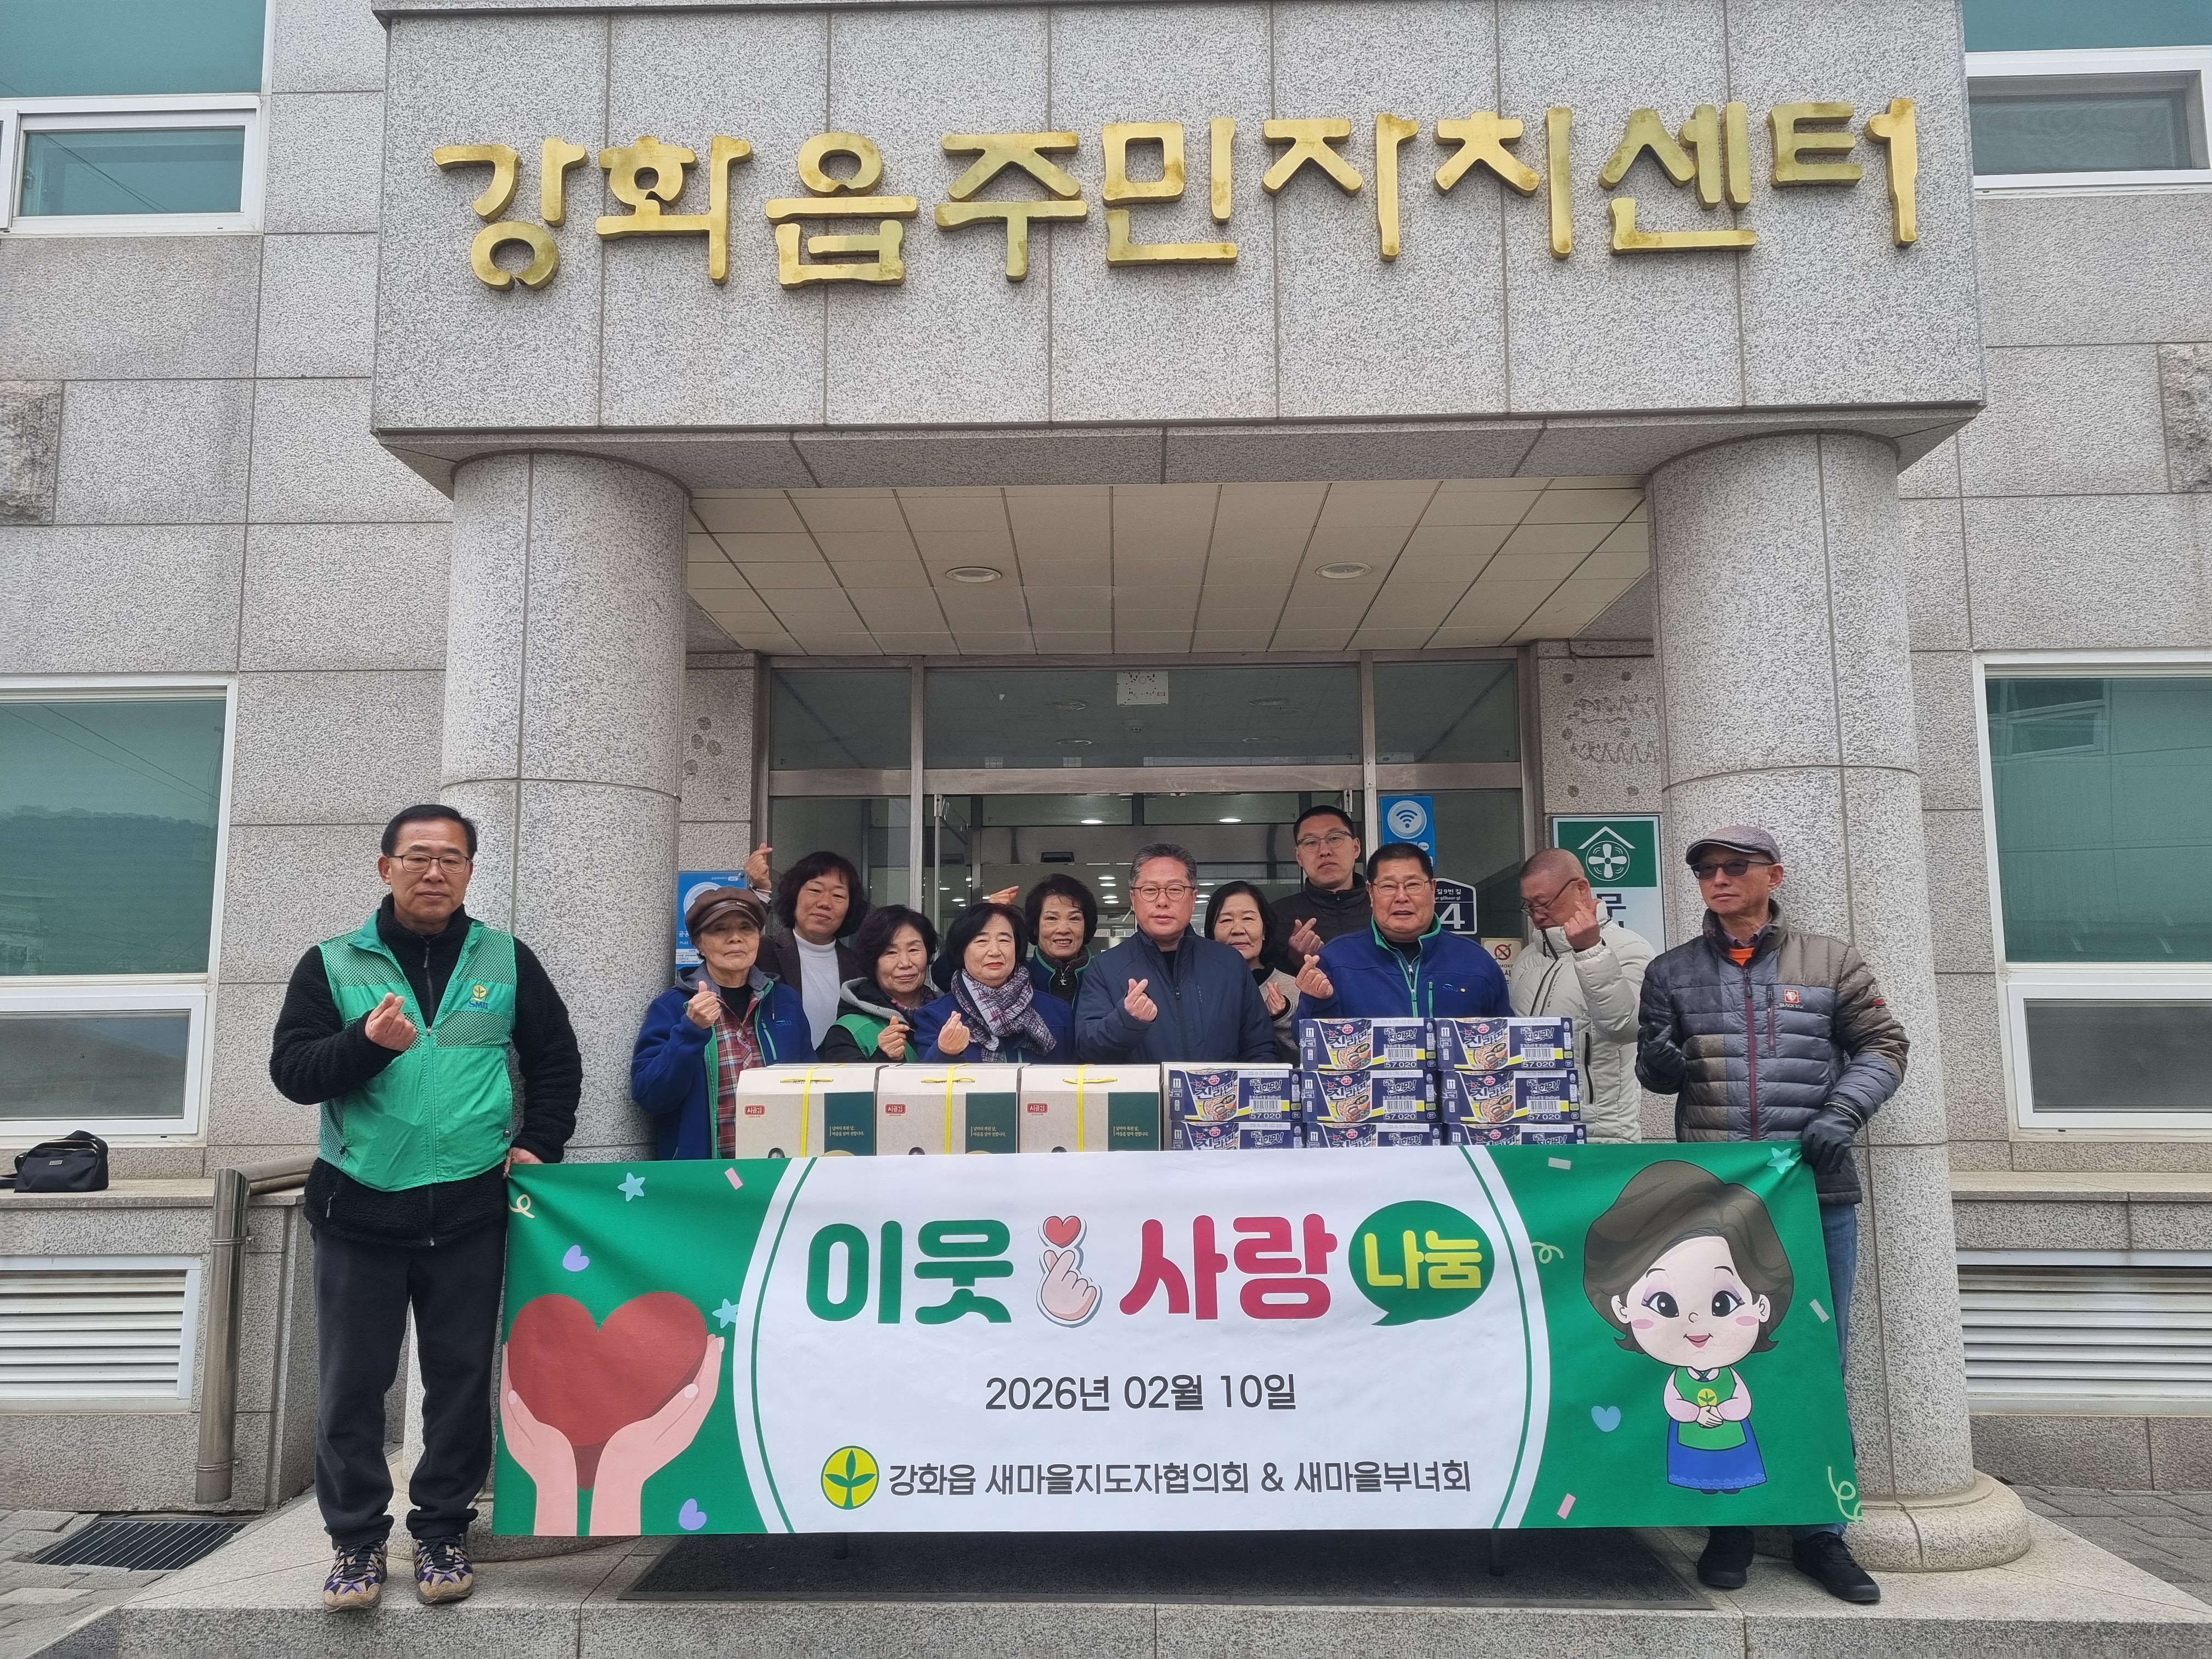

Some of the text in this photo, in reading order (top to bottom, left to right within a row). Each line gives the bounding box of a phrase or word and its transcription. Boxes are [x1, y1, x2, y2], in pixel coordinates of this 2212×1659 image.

[433, 98, 1916, 289] 강화읍주민자치센터
[469, 999, 488, 1010] SMU
[1328, 1029, 1368, 1049] 진라면
[1388, 1028, 1417, 1043] 진한맛!
[1464, 1028, 1504, 1049] 진라면
[1525, 1028, 1554, 1043] 진한맛!
[1195, 1080, 1234, 1101] 진라면
[1254, 1080, 1282, 1095] 진한맛!
[1327, 1080, 1367, 1102] 진라면
[1387, 1080, 1417, 1096] 진한맛!
[1470, 1080, 1511, 1102] 진라면
[1531, 1080, 1560, 1096] 진한맛!
[1255, 1132, 1284, 1147] 진한맛!
[806, 1213, 1483, 1324] 이웃 사랑 나눔
[985, 1374, 1296, 1412] 2026년 02월 10일
[889, 1459, 1471, 1496] 강화읍 새마을지도자협의회 & 새마을부녀회
